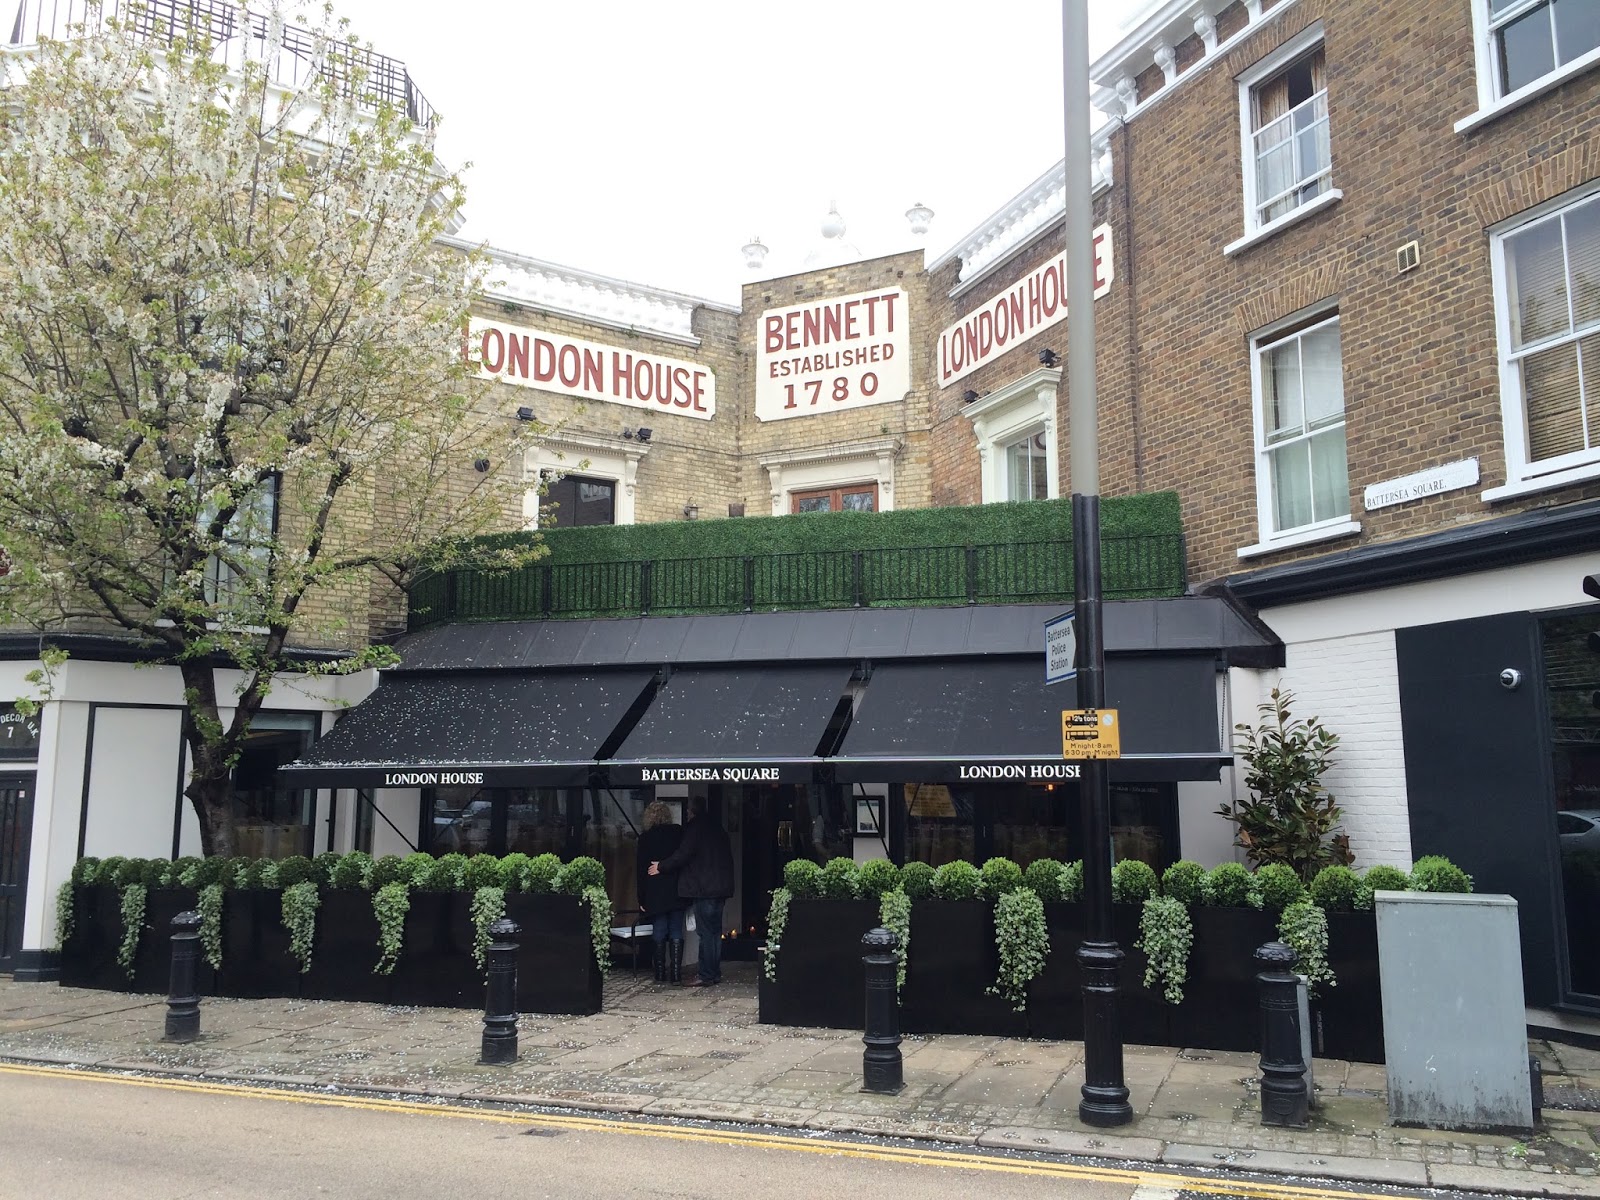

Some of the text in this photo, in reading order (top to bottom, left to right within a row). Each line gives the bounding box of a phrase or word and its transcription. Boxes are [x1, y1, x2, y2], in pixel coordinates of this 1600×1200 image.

[942, 233, 1106, 380] LONDON HOUE
[766, 293, 899, 354] BENNETT
[461, 320, 708, 413] LONDON HOUSE
[770, 343, 894, 379] ESTABLISHED
[784, 372, 879, 410] 1780
[1367, 489, 1409, 507] BATTERSEA
[1048, 626, 1071, 643] Battersea
[1052, 643, 1067, 656] Police
[1051, 657, 1069, 671] Station
[7, 726, 14, 738] 7
[385, 772, 484, 785] LONDON HOUSE
[642, 768, 779, 782] BATTERSEA SQUARE
[960, 765, 1026, 778] LONDON
